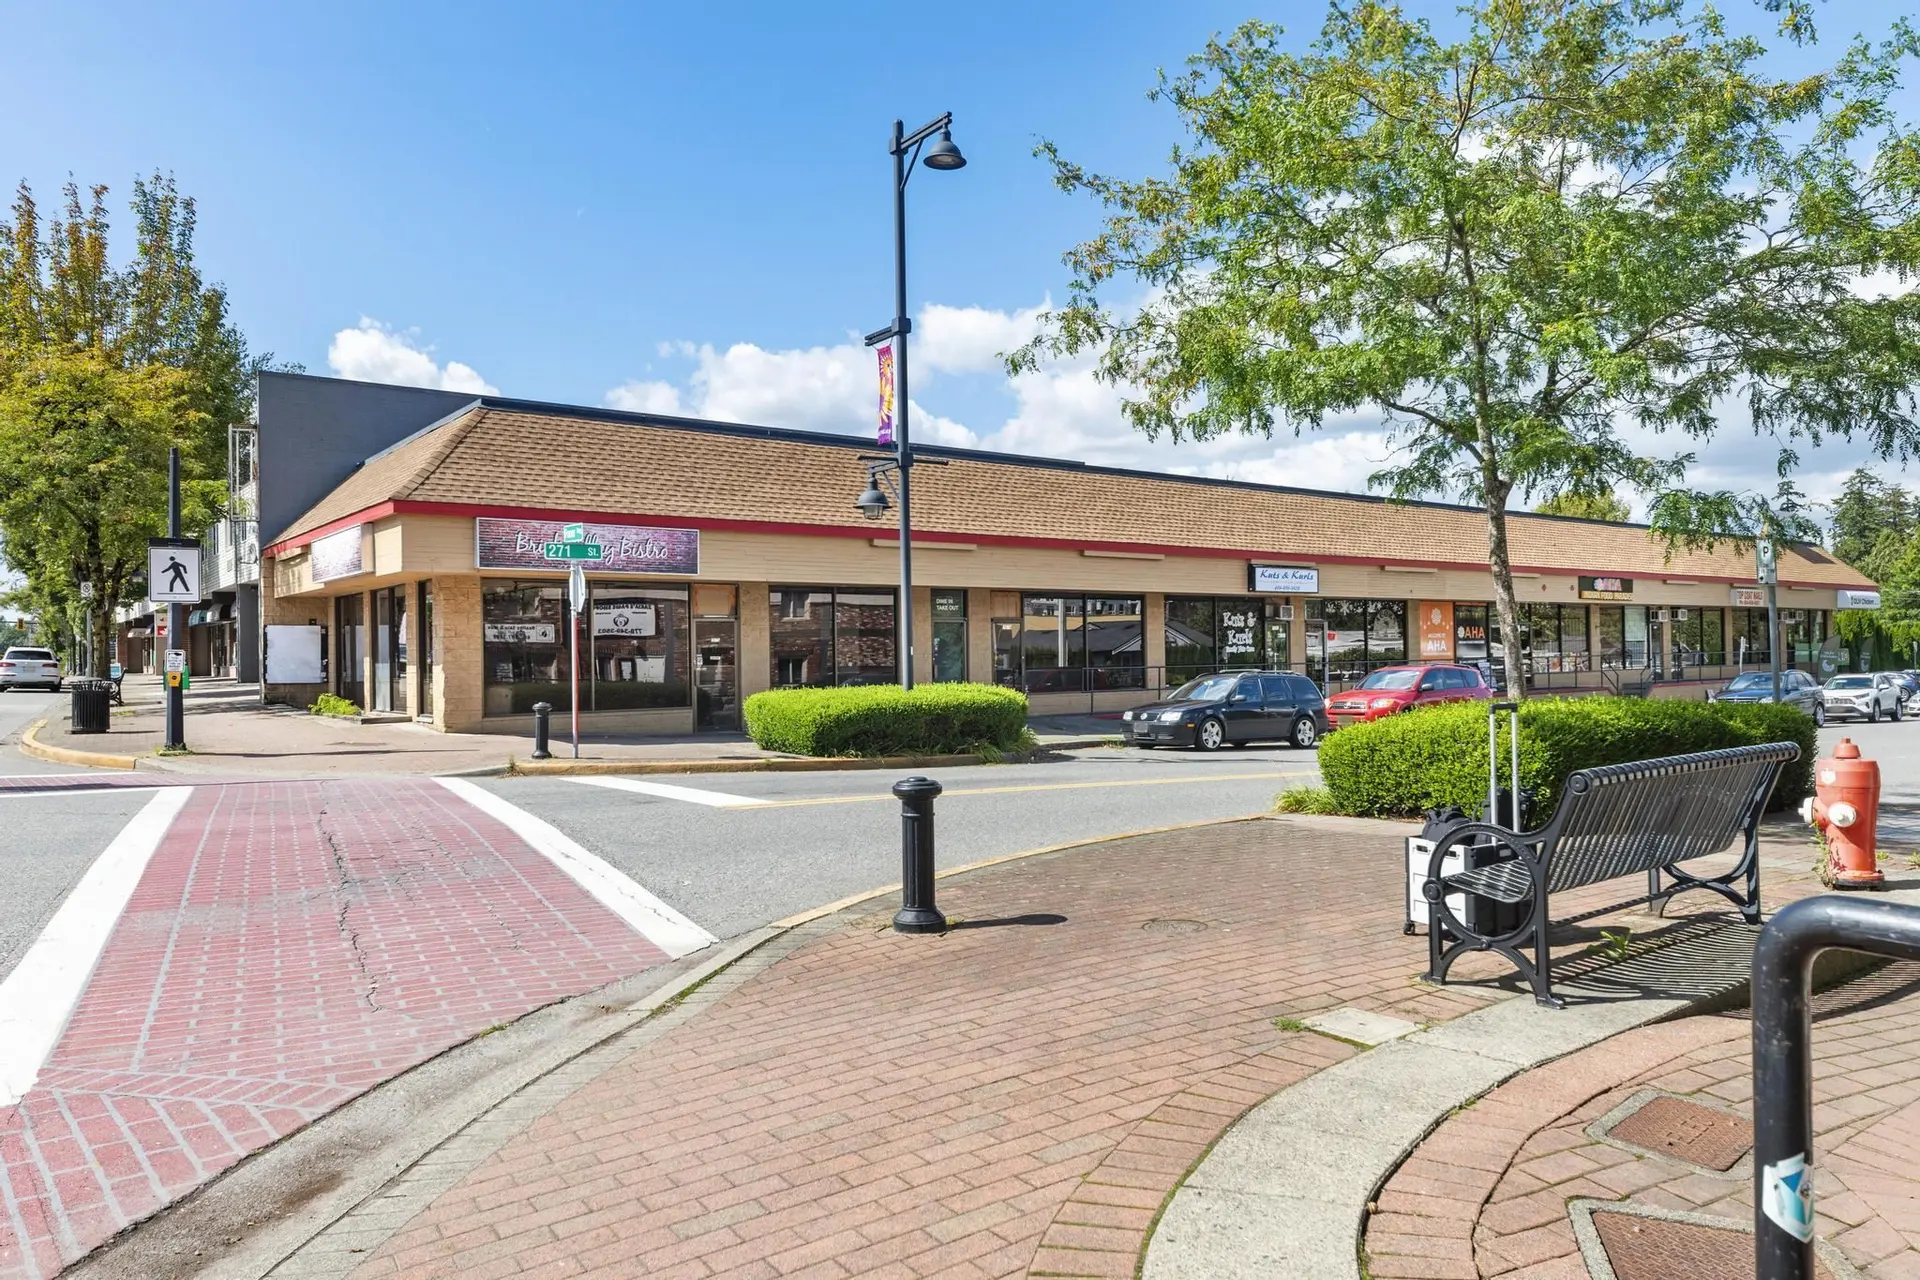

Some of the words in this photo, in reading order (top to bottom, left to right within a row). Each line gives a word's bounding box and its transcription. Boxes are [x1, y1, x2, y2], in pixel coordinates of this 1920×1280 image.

[548, 545, 571, 558] 271
[587, 547, 599, 556] St.
[619, 536, 668, 559] Bistro
[1260, 569, 1280, 579] Kuts
[1291, 570, 1314, 580] Kurls
[1223, 612, 1245, 628] Kuts
[1247, 612, 1257, 628] &
[1227, 628, 1253, 645] Kurls
[1464, 626, 1486, 639] AHA
[1427, 639, 1447, 652] AHA
